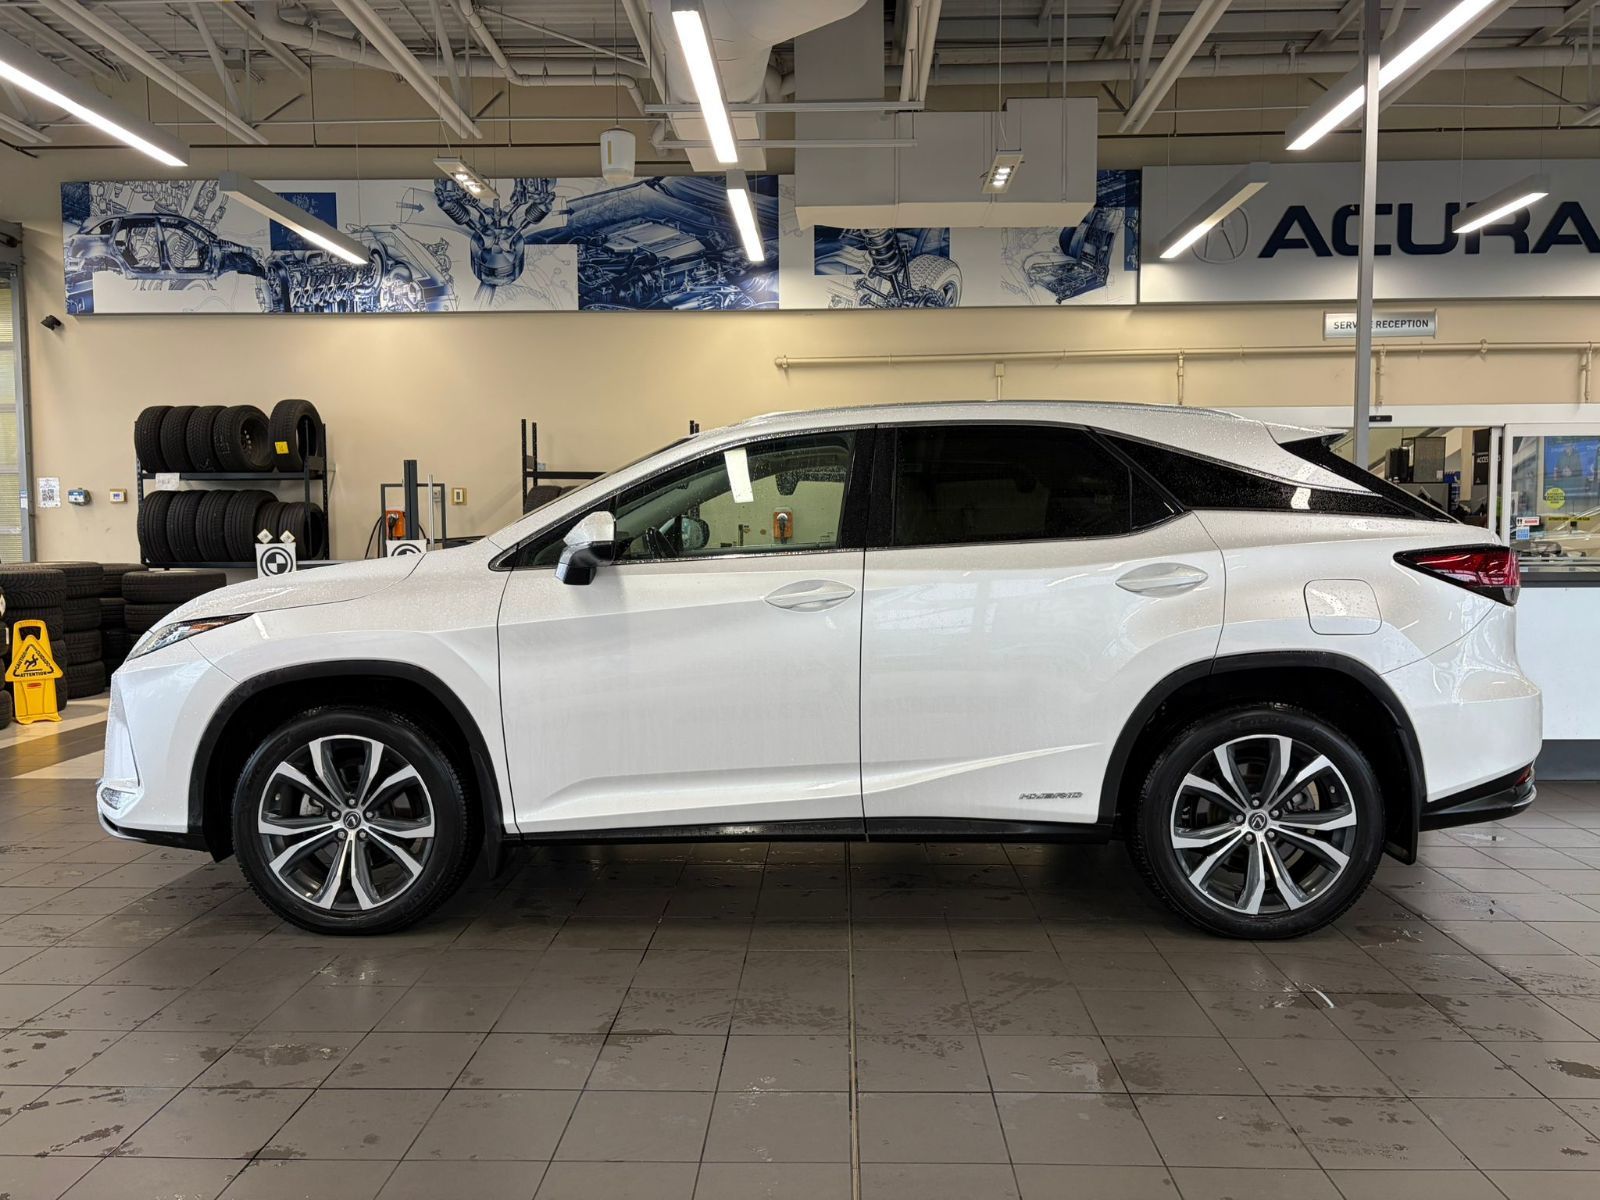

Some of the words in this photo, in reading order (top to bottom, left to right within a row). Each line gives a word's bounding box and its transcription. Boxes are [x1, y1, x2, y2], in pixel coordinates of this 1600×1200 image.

[1257, 201, 1600, 258] ACURA
[1333, 320, 1373, 330] SERV
[1375, 319, 1429, 329] RECEPTION
[15, 652, 27, 669] CAUTION
